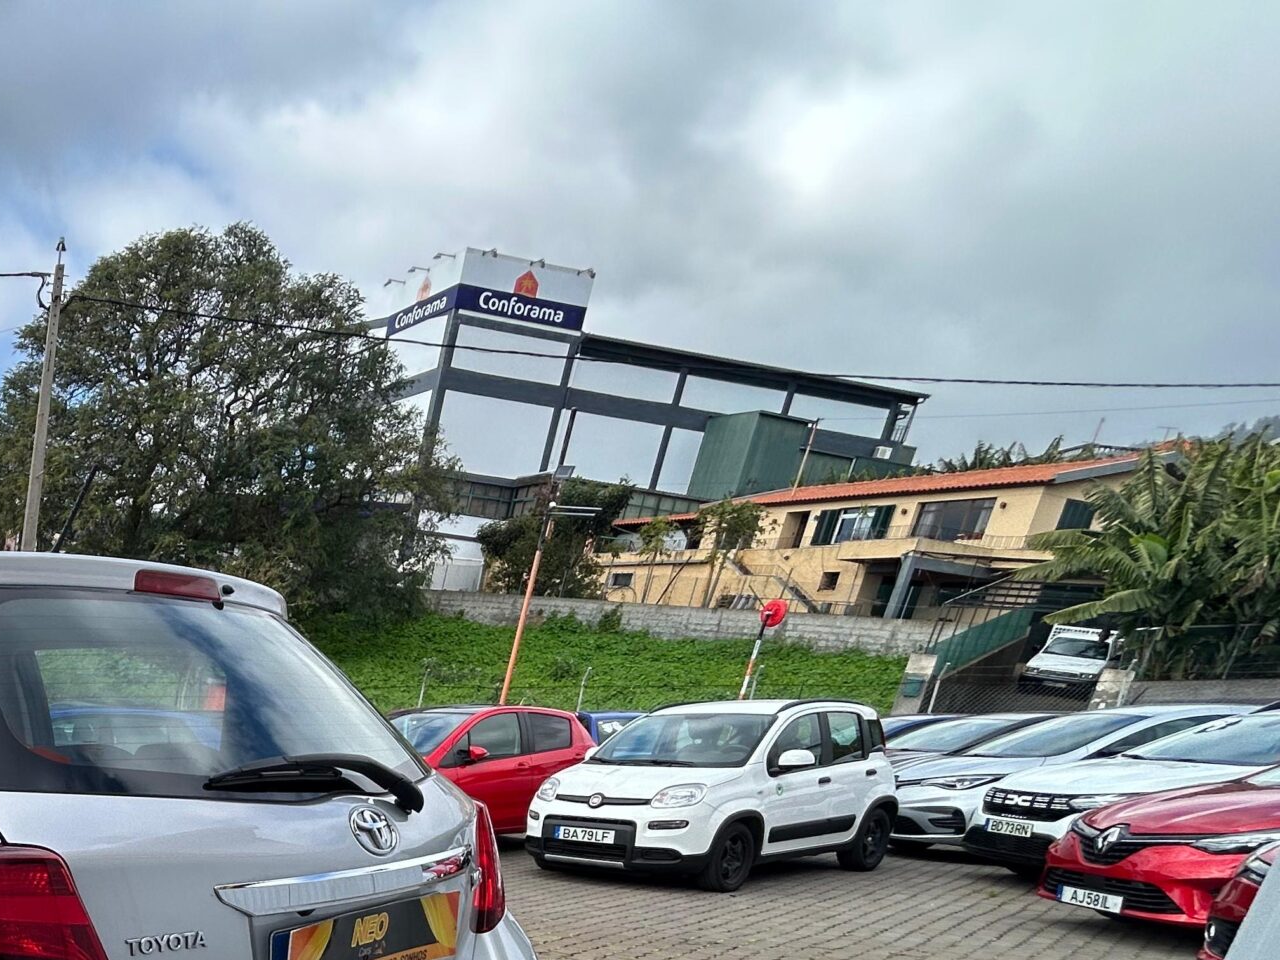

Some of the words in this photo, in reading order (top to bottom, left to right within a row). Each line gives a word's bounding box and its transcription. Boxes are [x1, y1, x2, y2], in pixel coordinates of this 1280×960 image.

[394, 295, 447, 329] Conforama
[479, 292, 564, 323] Conforama
[125, 930, 208, 957] TOYOTA
[350, 912, 390, 948] NEO
